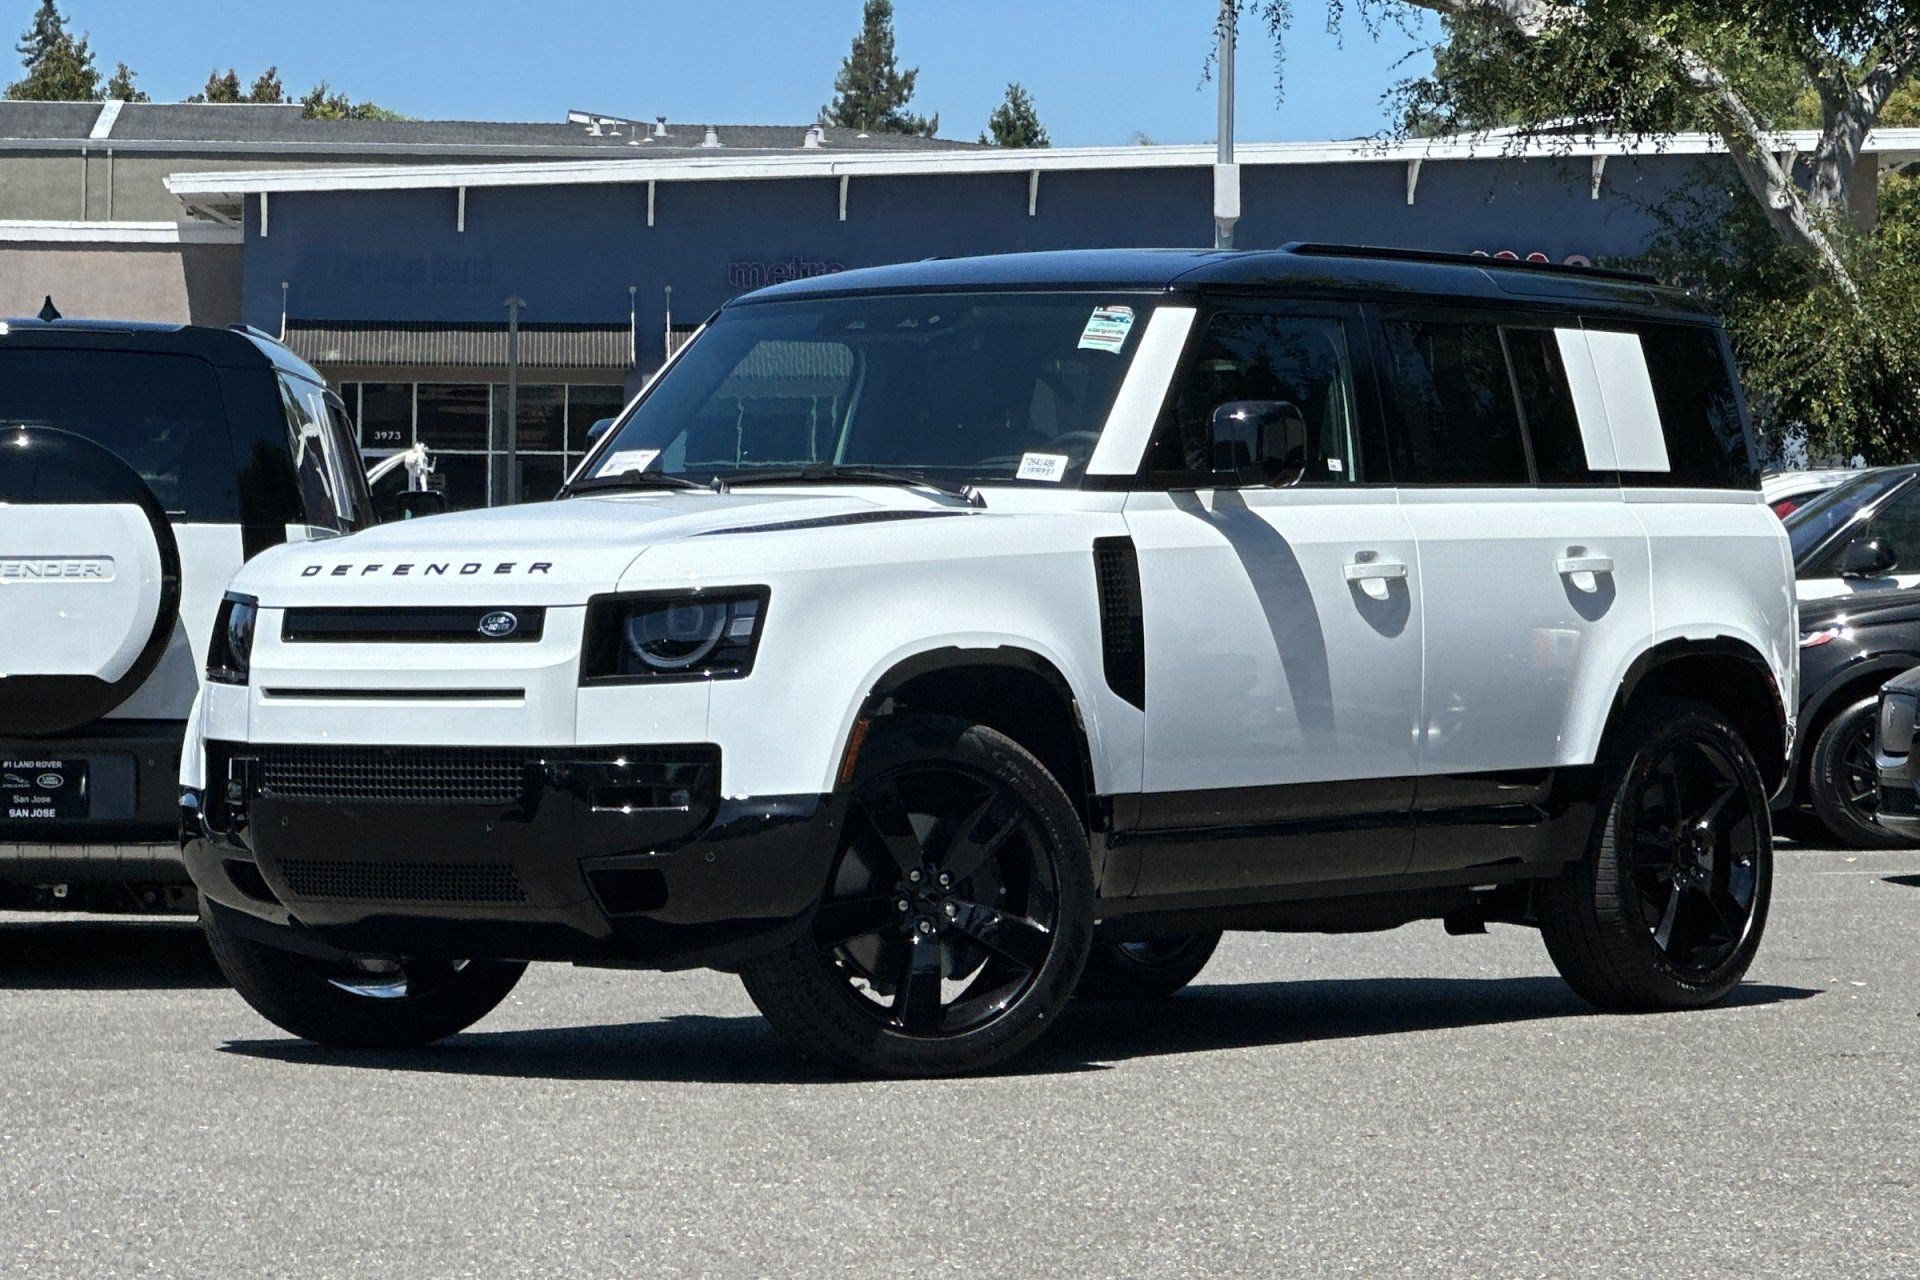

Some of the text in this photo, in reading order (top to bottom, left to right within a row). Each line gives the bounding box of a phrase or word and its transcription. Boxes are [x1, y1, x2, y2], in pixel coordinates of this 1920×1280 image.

[374, 430, 401, 440] 3973
[0, 561, 103, 578] ENDER
[301, 562, 553, 577] DEFENDER
[13, 795, 51, 803] San Jose
[9, 808, 55, 817] SAN JOSE
